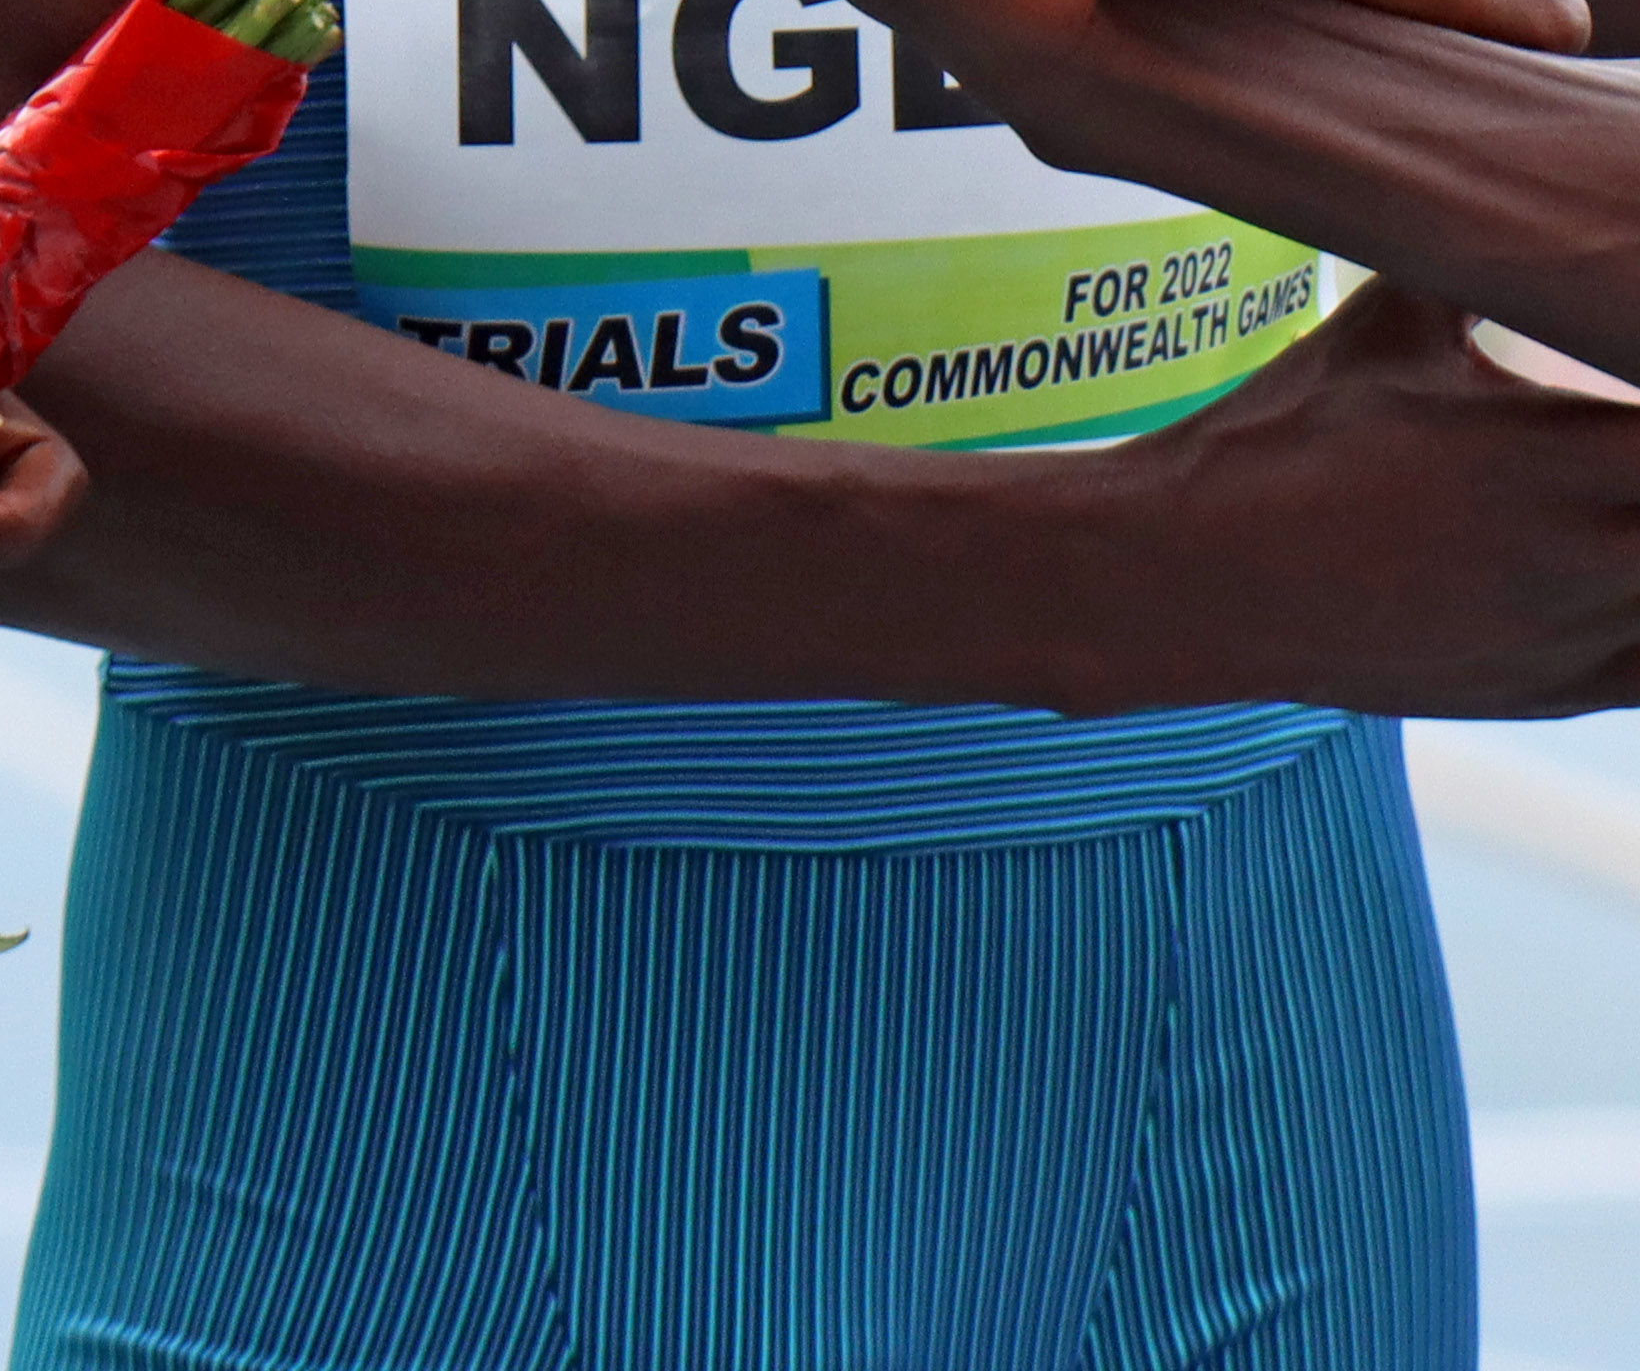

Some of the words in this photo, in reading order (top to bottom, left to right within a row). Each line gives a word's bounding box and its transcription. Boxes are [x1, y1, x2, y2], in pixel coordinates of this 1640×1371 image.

[840, 299, 1230, 414] COMMONWEALTH
[1237, 262, 1314, 338] GAMES
[1063, 263, 1148, 323] FOR
[1158, 239, 1233, 306] 2022
